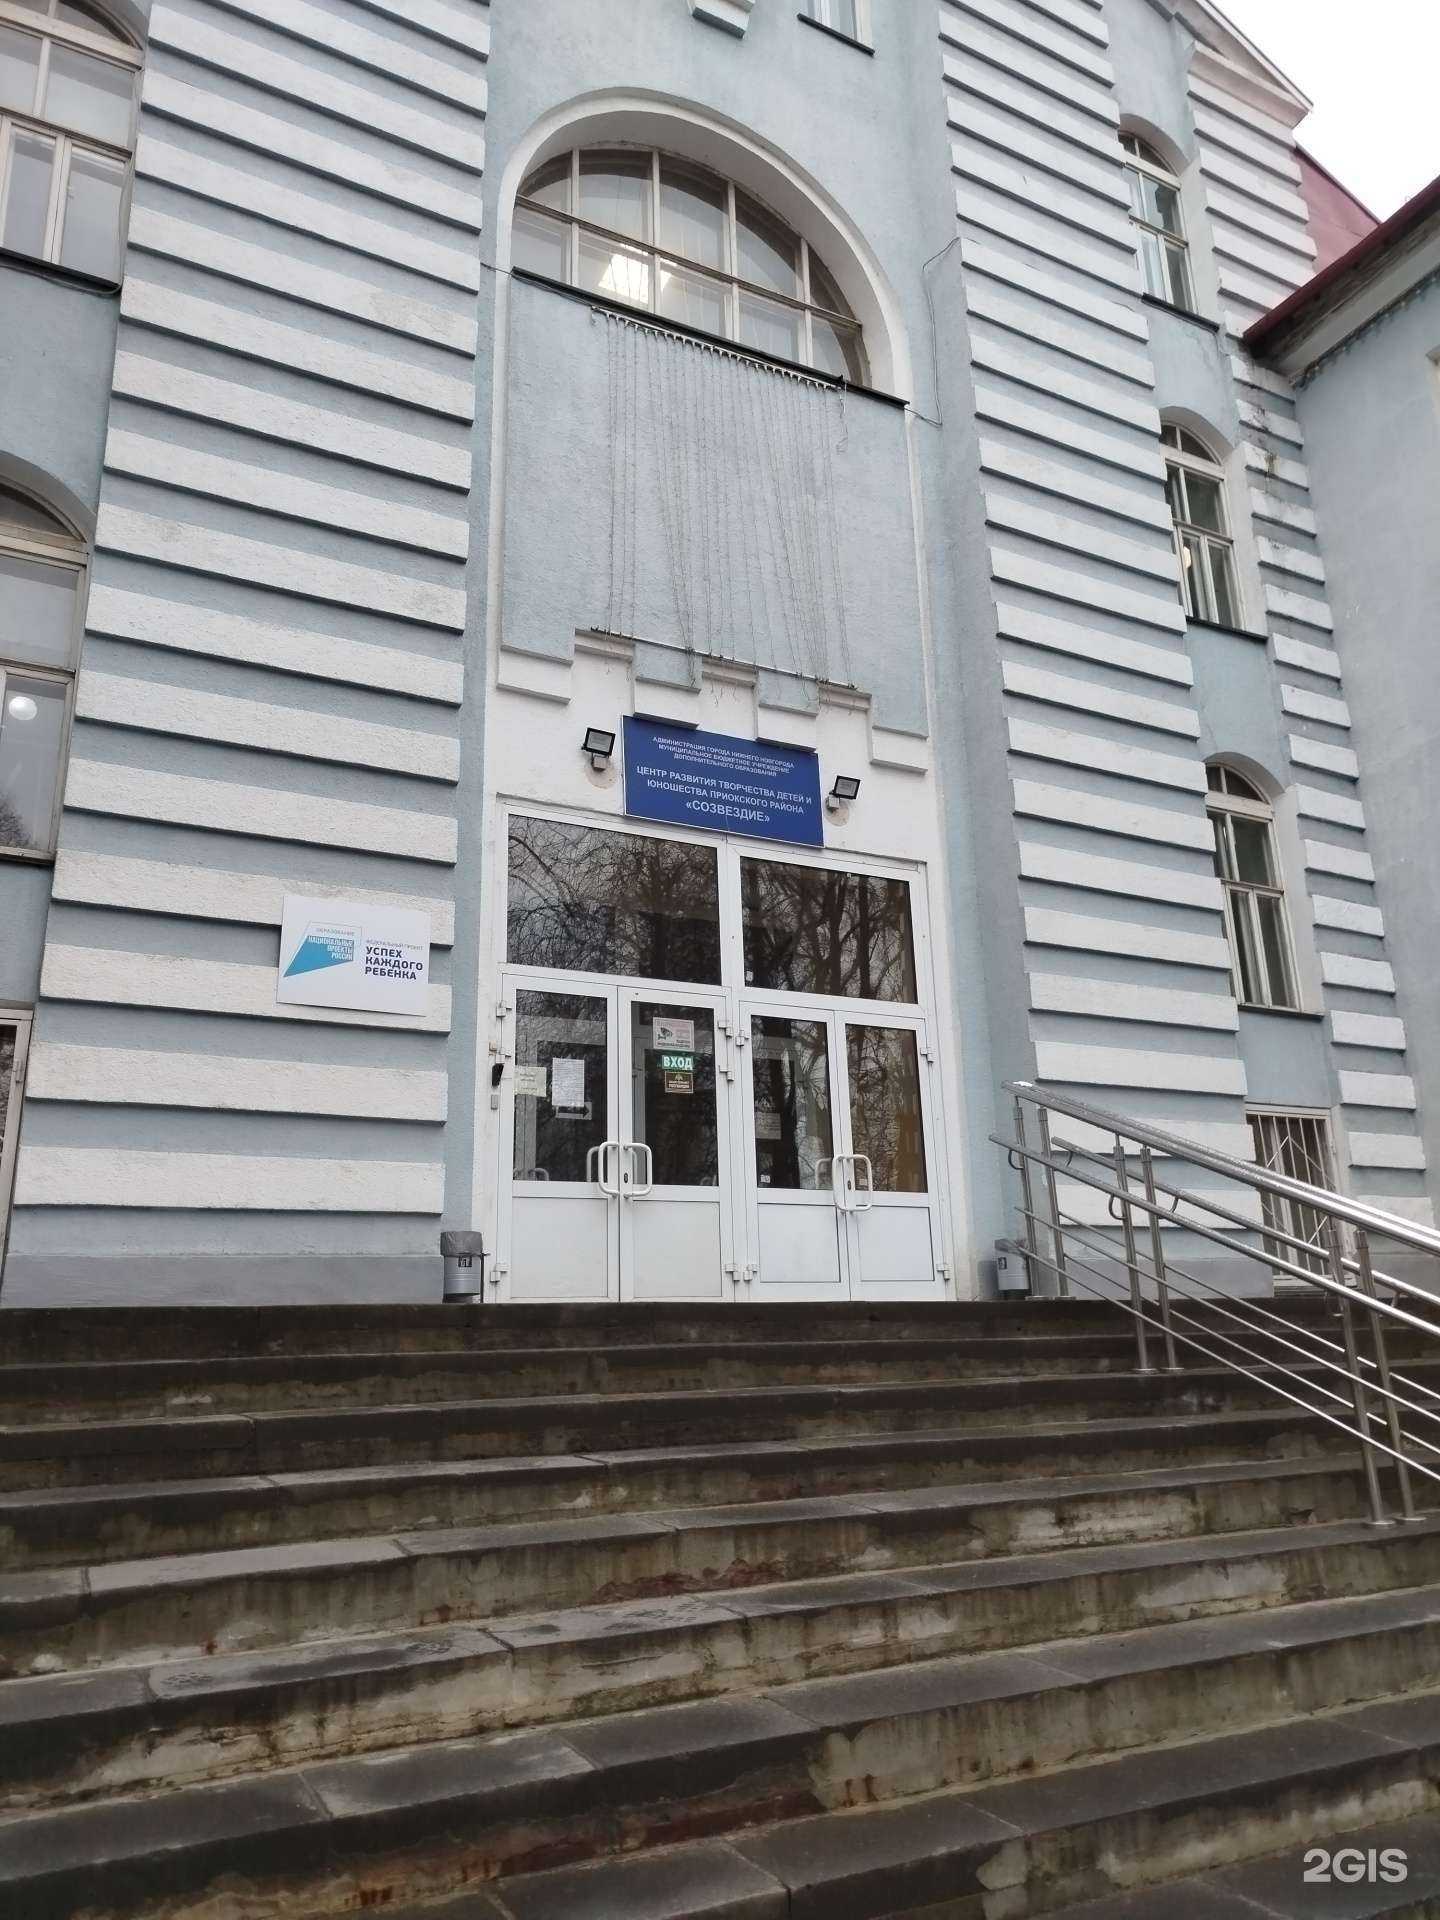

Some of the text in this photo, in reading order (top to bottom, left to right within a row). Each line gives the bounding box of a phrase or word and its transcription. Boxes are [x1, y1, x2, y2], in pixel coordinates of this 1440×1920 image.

[636, 766, 812, 805] ЦЕНТР РАЗВИТИЯ ТВОРЧЕСТВА ДЕТЕЙ И
[647, 779, 804, 814] ЮНОШЕСТВА ПРИОКСКОГО РАЙОНА
[685, 800, 770, 822] «СОЗВЕЗДИЕ»
[366, 946, 402, 959] УСПЕХ
[365, 956, 423, 971] КАЖДОГО
[364, 966, 417, 980] РЕБЕНКА
[663, 1055, 693, 1071] ВХОД
